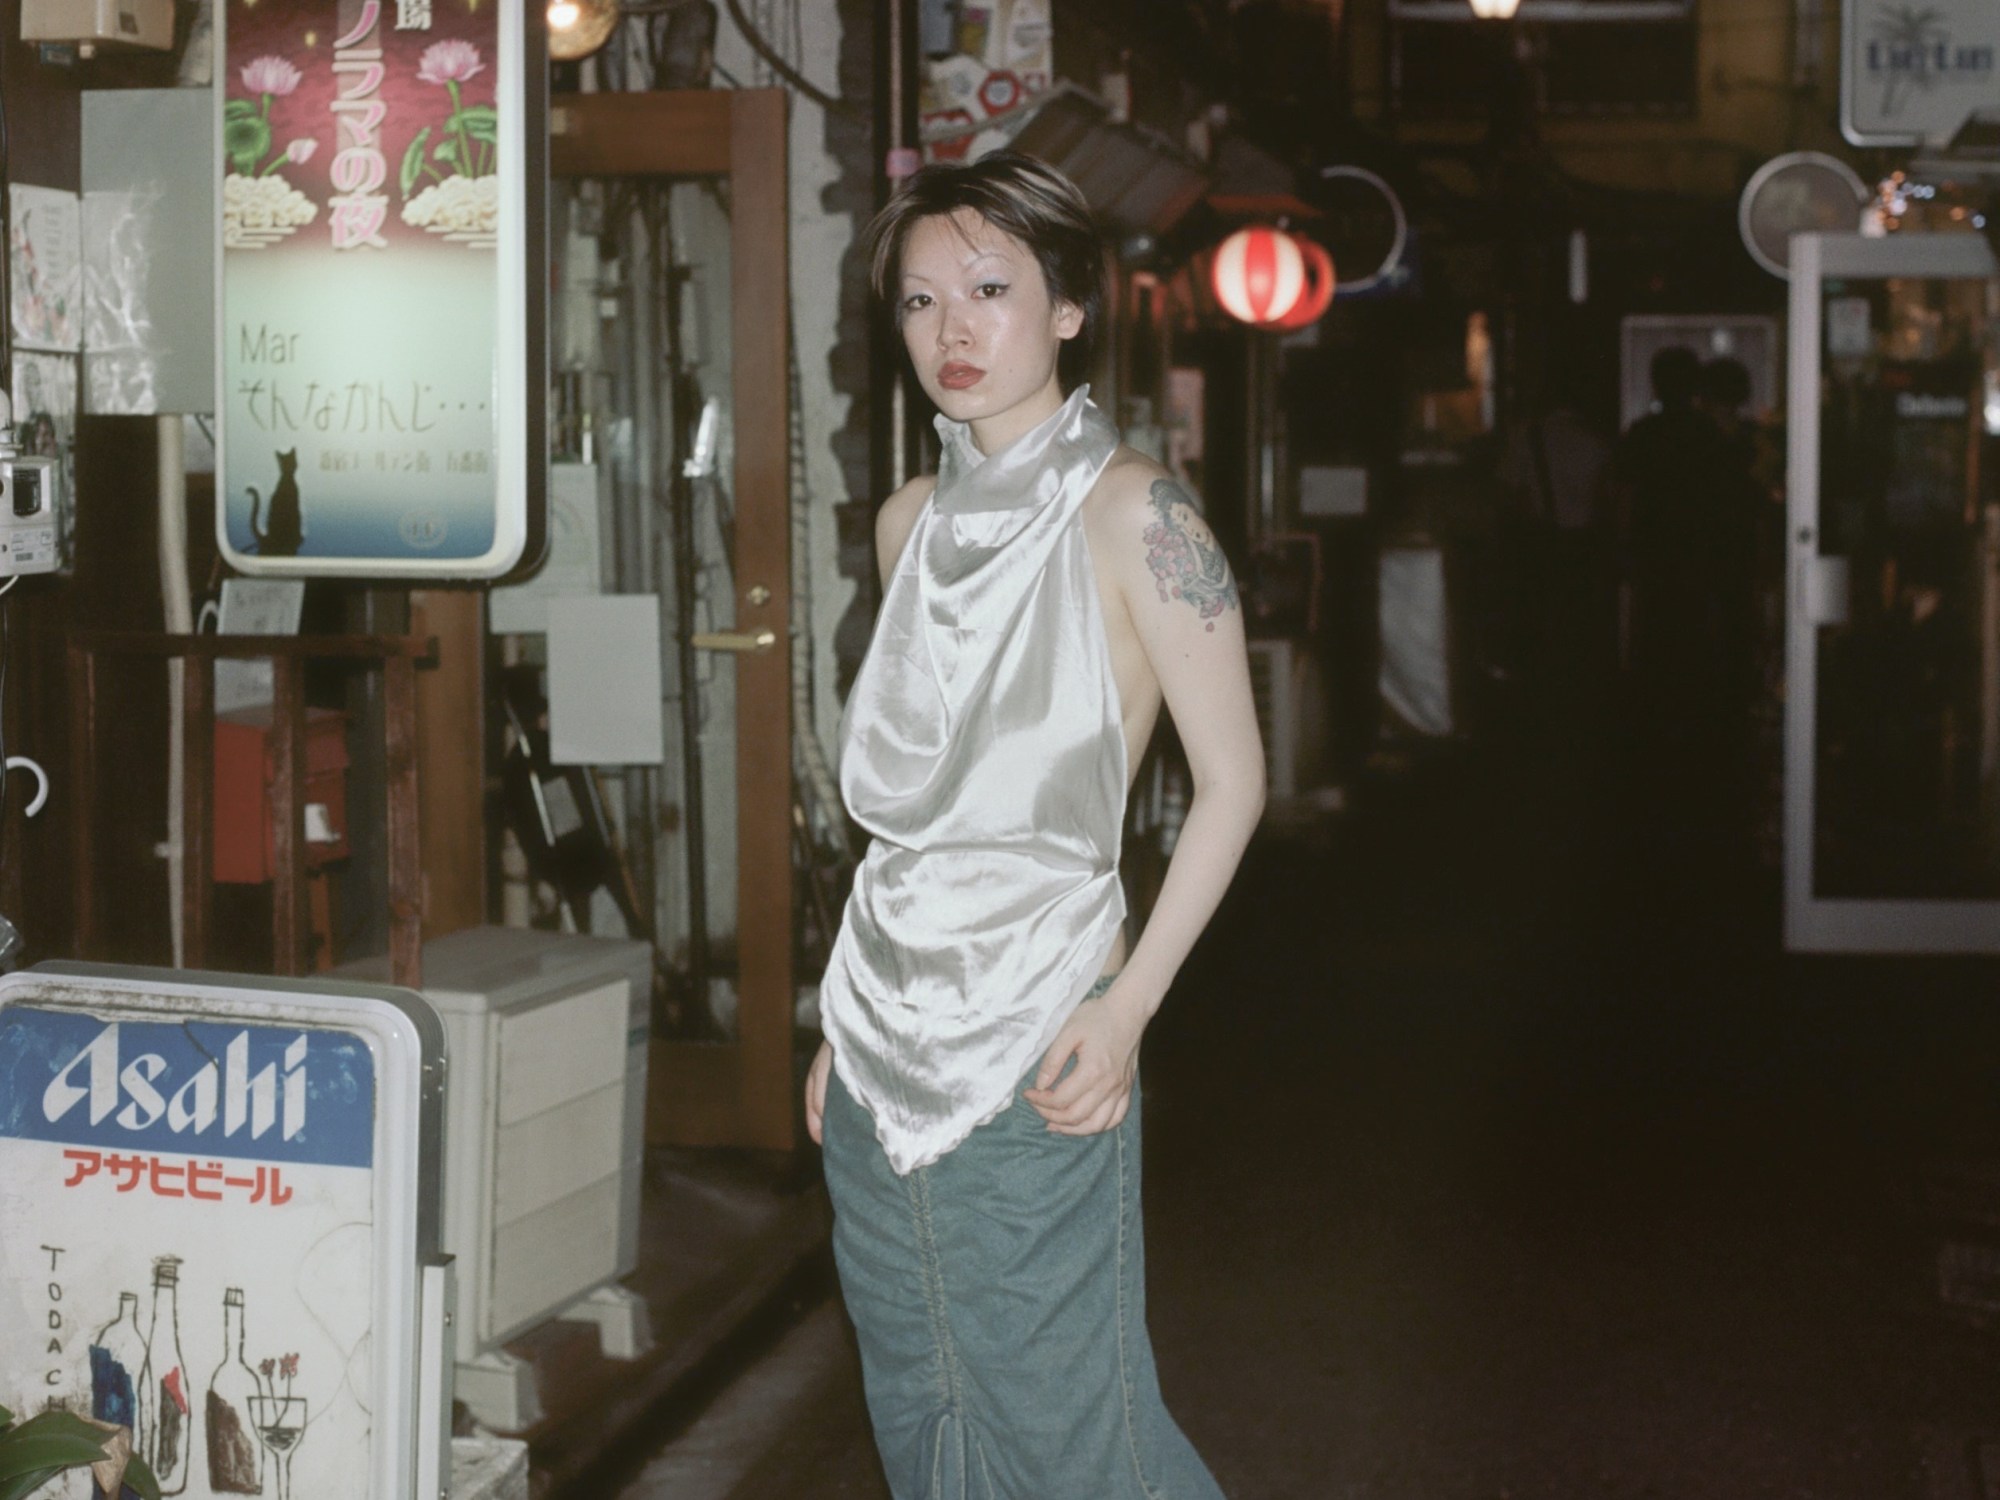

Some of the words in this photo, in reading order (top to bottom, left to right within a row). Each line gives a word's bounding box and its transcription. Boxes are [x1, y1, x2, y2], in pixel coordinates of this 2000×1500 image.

[240, 323, 300, 364] Mar
[43, 1023, 308, 1142] Asahi
[63, 1149, 293, 1206] アサヒビール
